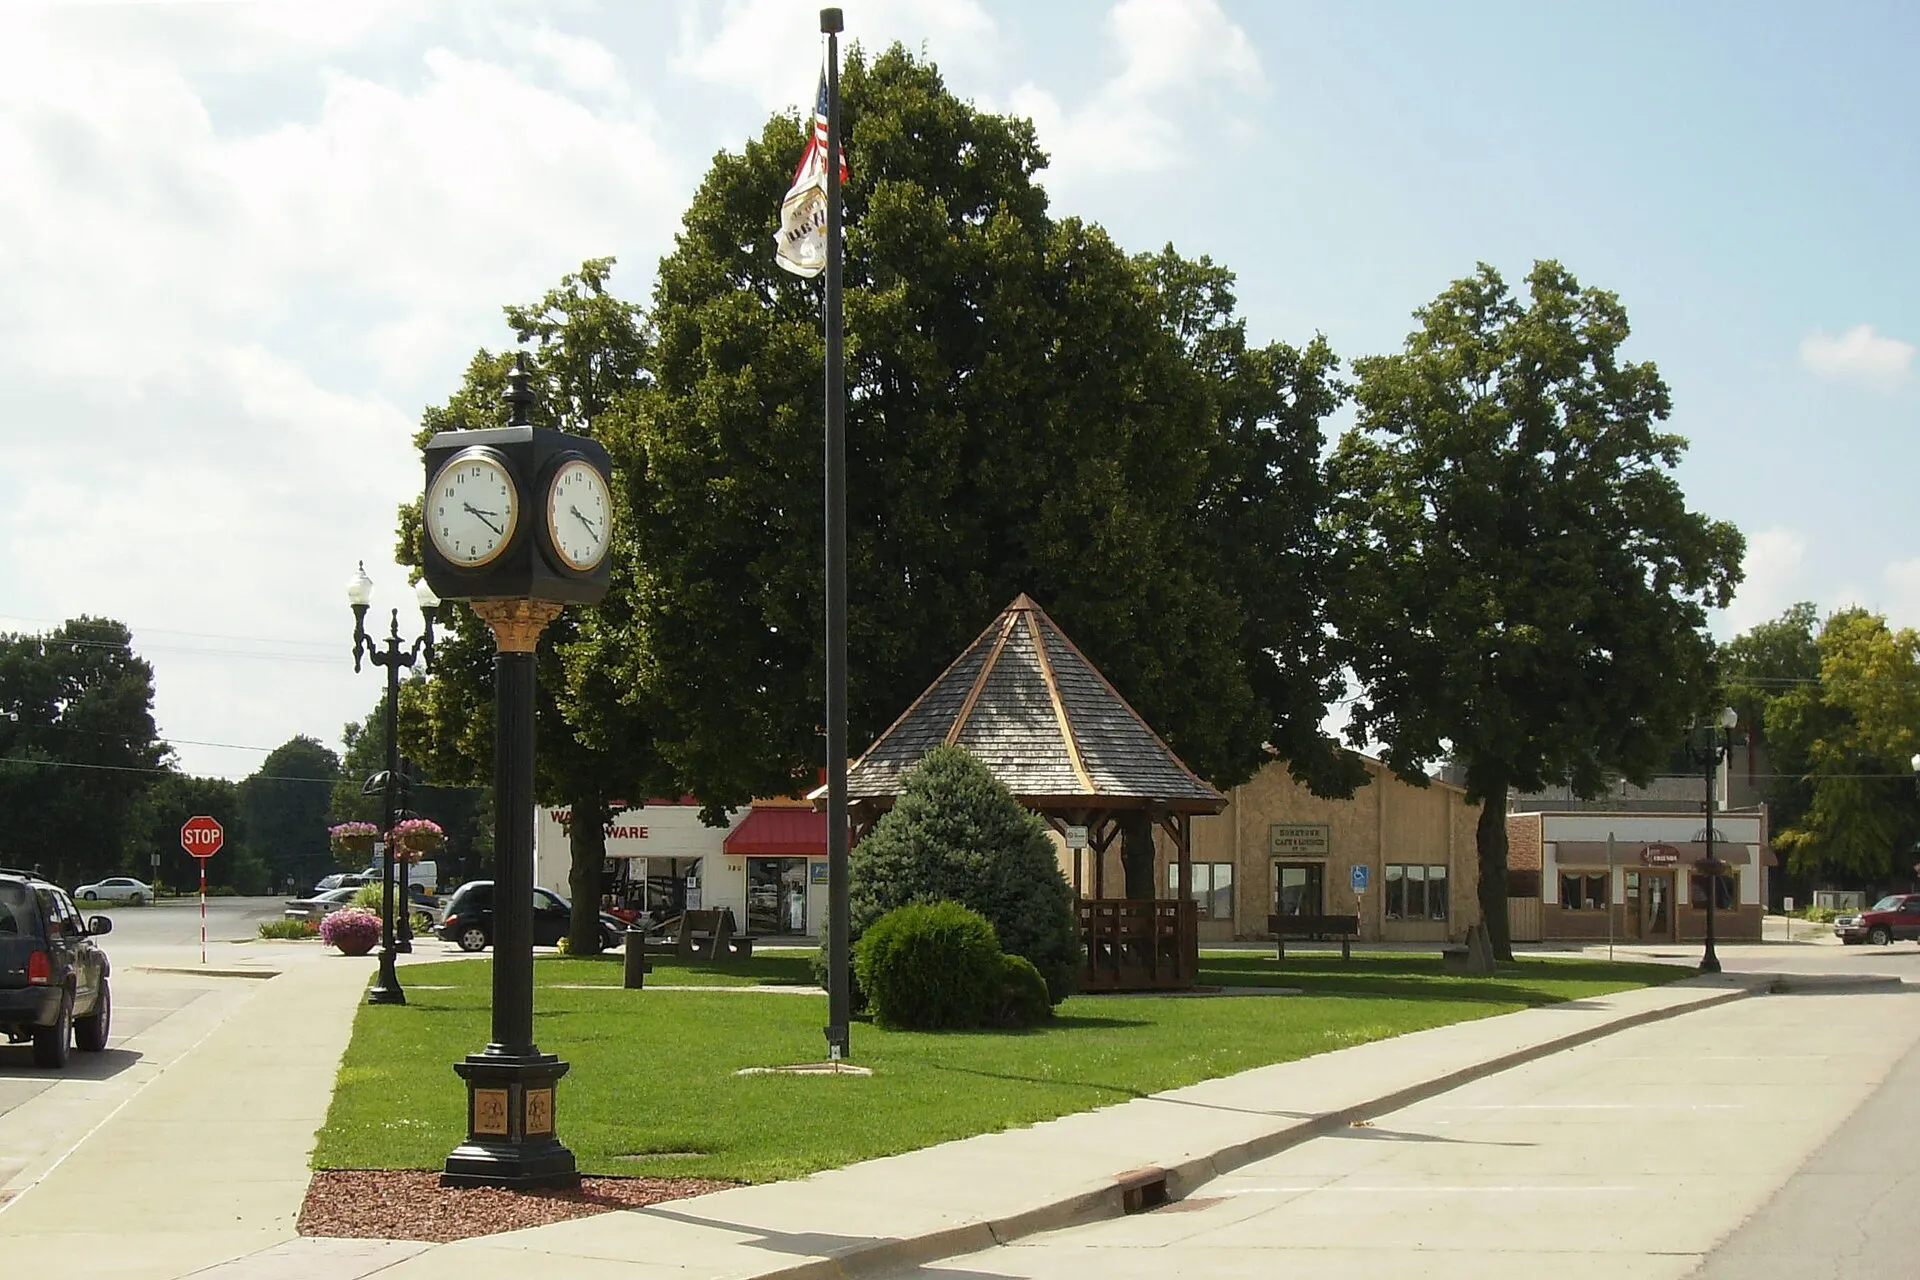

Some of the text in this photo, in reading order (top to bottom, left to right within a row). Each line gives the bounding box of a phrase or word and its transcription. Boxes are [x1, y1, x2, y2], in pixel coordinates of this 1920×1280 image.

[472, 467, 480, 477] 12
[457, 474, 464, 484] 11
[445, 488, 454, 497] 10
[501, 485, 506, 495] 2
[439, 507, 444, 516] 9
[443, 528, 449, 537] 8
[455, 541, 460, 550] 7
[487, 539, 493, 549] 5
[471, 545, 476, 555] 6
[185, 829, 220, 844] STOP
